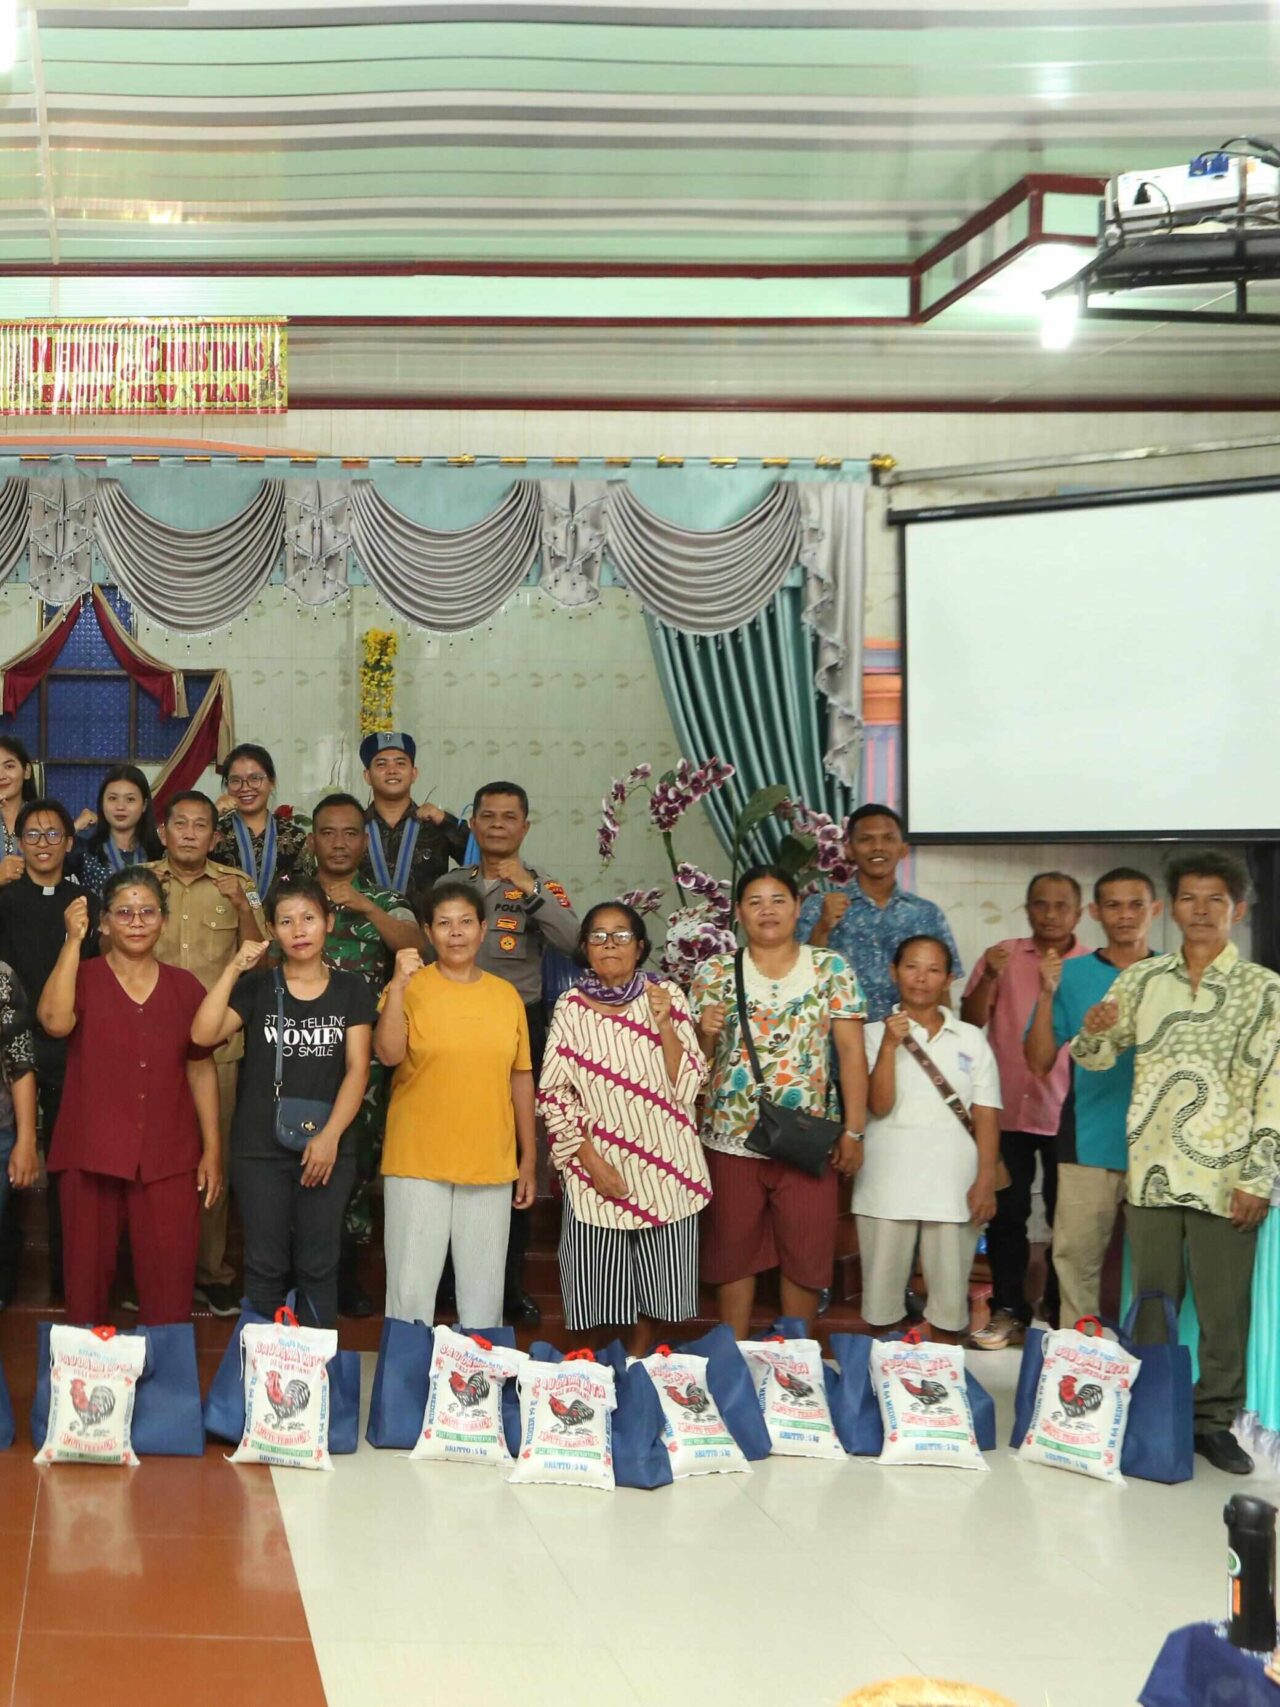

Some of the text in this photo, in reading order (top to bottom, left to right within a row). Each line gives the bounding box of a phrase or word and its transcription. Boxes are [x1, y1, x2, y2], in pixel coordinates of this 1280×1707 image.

[144, 335, 265, 372] CHRISTMAS
[41, 384, 251, 402] HAPPY NEW YEAR
[300, 1015, 346, 1028] TELLING
[263, 1026, 344, 1046] WOMEN
[275, 1044, 334, 1057] O SMILE
[886, 1401, 898, 1431] MEDIUM
